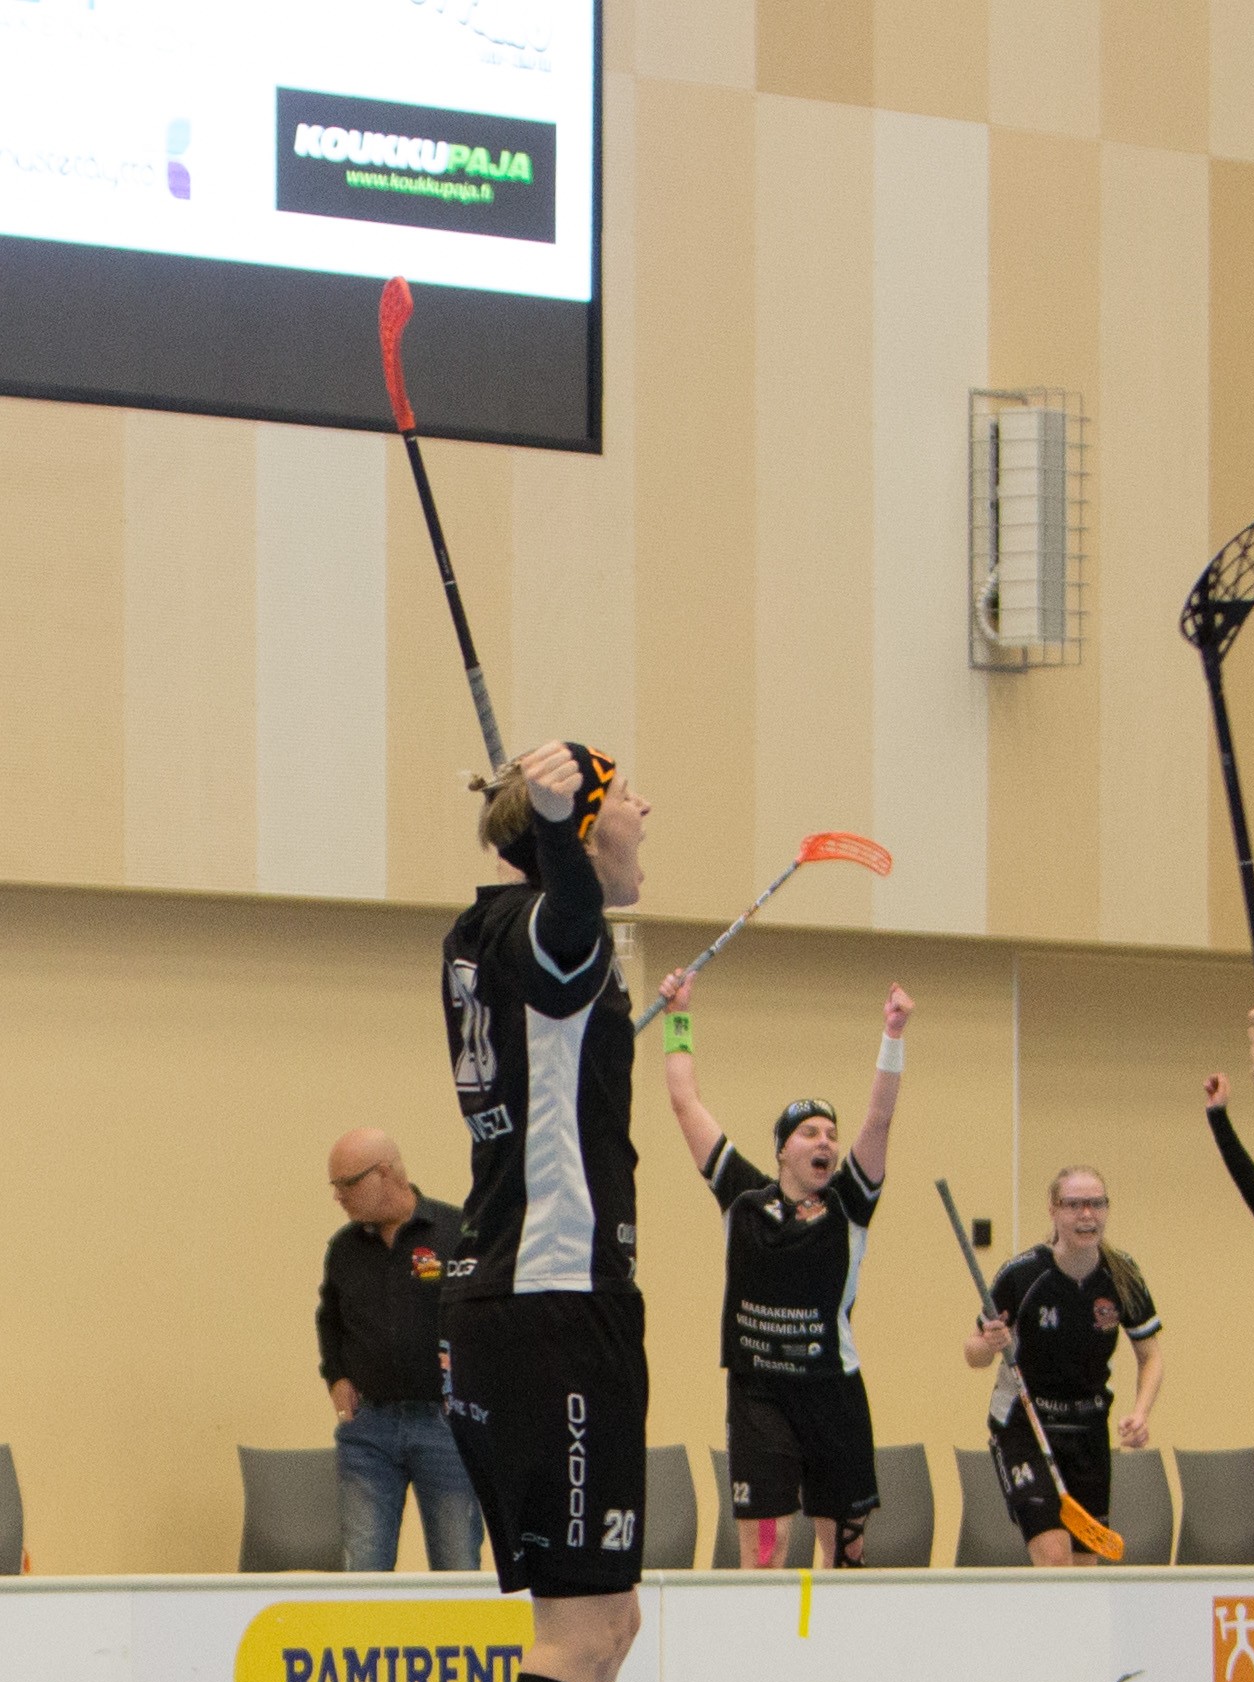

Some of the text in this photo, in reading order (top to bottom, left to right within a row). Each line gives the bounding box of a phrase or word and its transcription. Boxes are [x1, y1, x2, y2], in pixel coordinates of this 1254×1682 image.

[293, 122, 534, 185] KOUKKUPAJA
[344, 166, 494, 205] www.koukkupaja.fi
[1038, 1305, 1058, 1328] 24
[566, 1392, 587, 1548] OXDOG
[1011, 1461, 1036, 1488] 24
[732, 1481, 751, 1505] 22
[600, 1507, 637, 1552] 20
